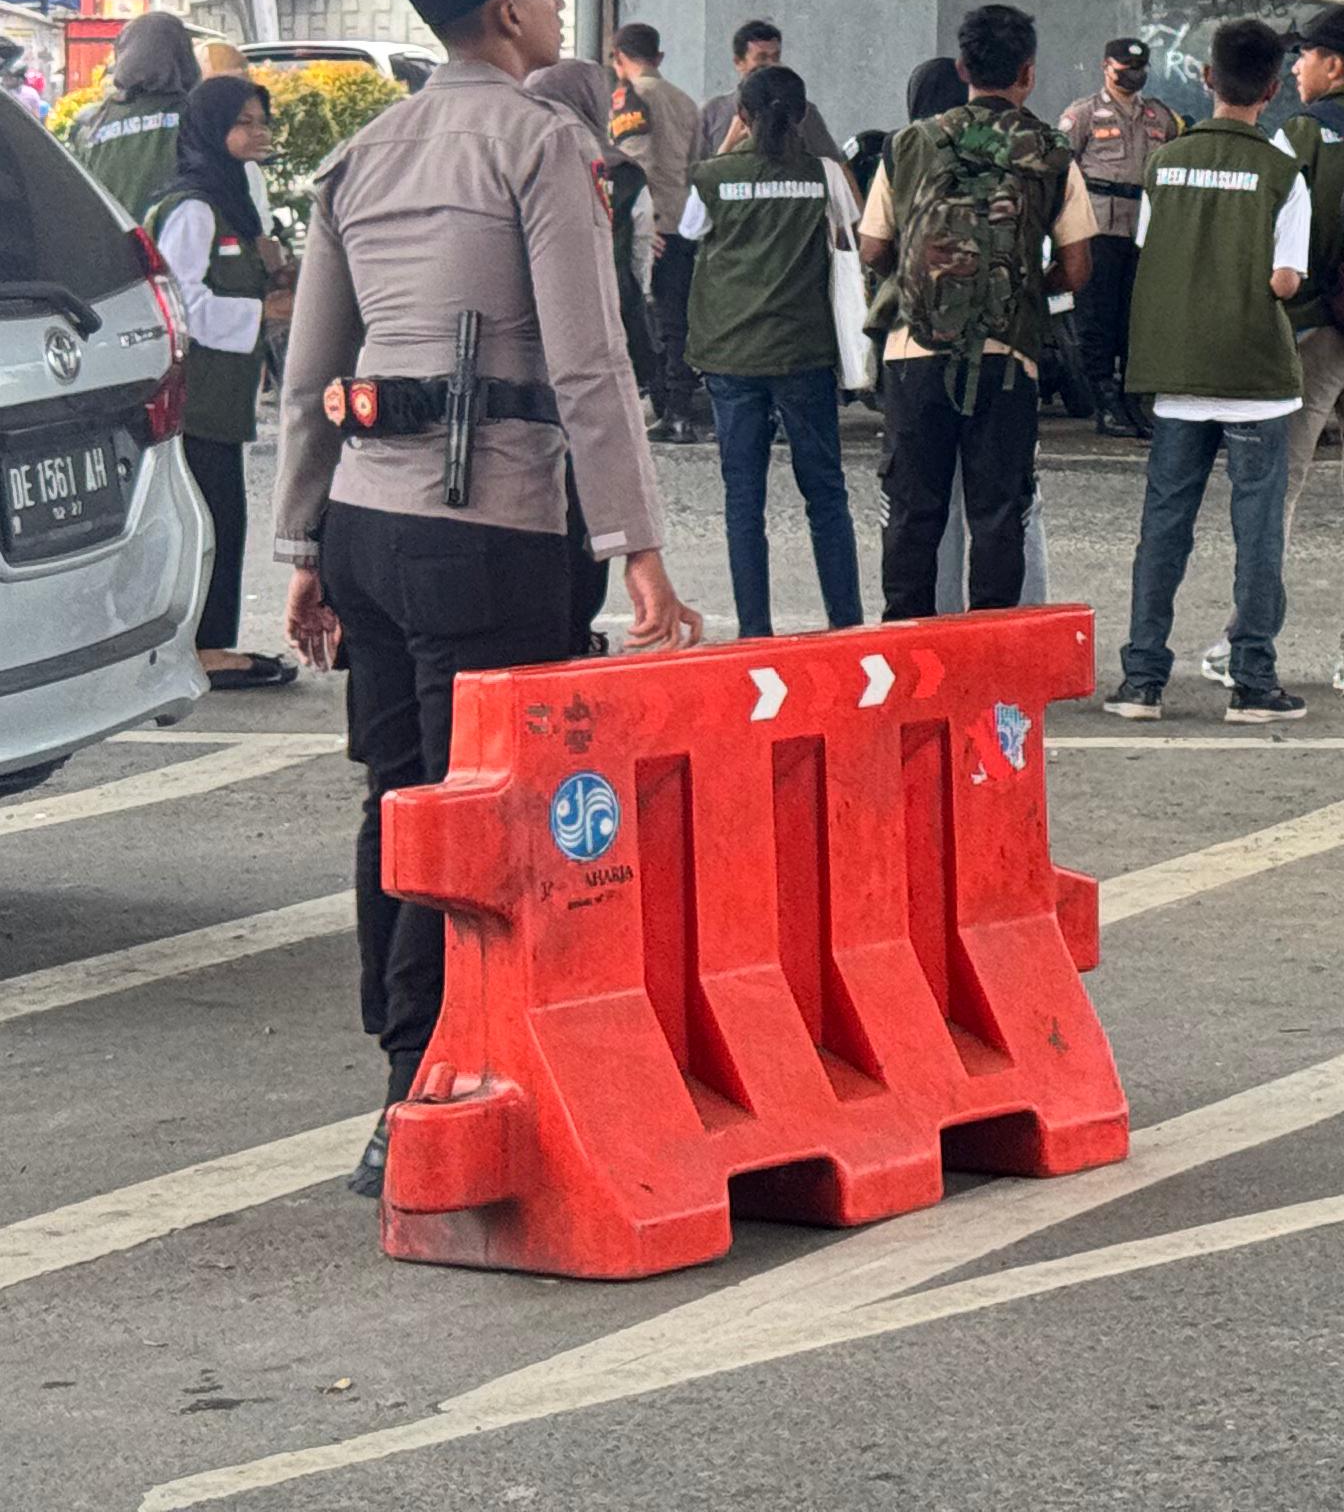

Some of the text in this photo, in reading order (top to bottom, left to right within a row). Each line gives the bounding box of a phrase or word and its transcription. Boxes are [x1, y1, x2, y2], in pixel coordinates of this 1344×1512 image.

[9, 448, 108, 510] DE 1561 AH
